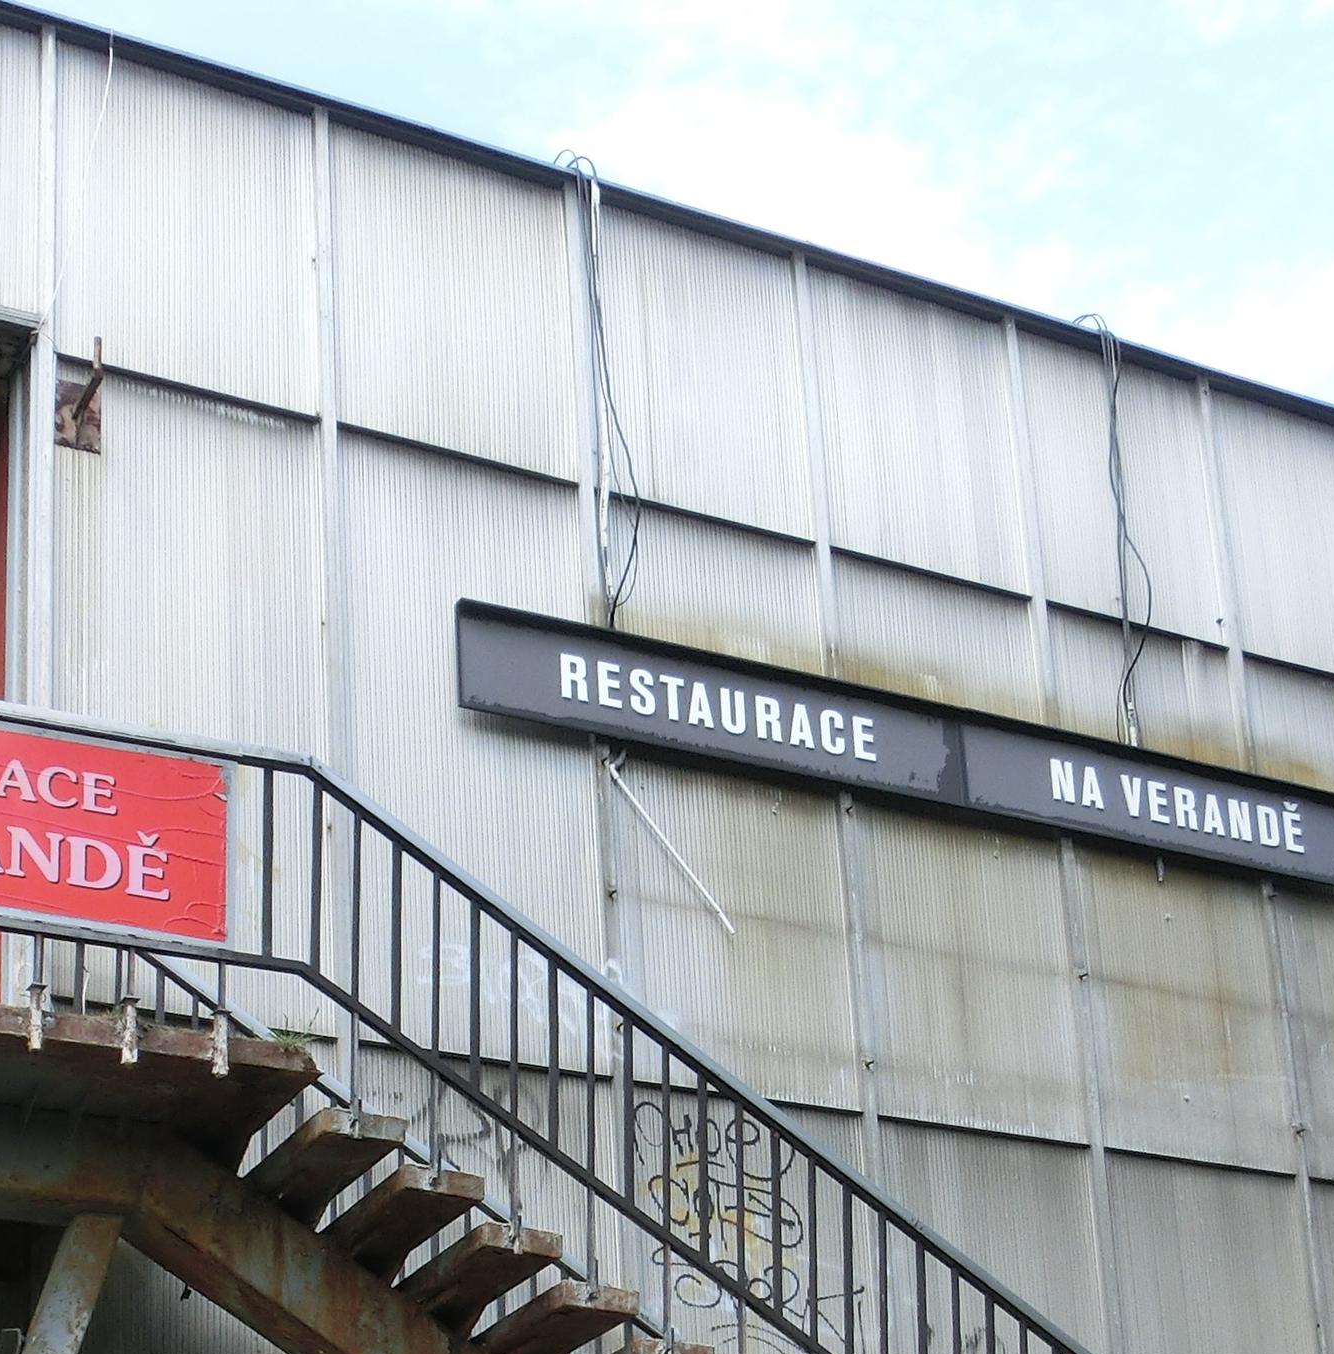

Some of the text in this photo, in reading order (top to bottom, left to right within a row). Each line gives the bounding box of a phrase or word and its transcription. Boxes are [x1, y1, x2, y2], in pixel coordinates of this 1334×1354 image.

[559, 653, 1307, 854] RESTAURACE NA VERANDĚ
